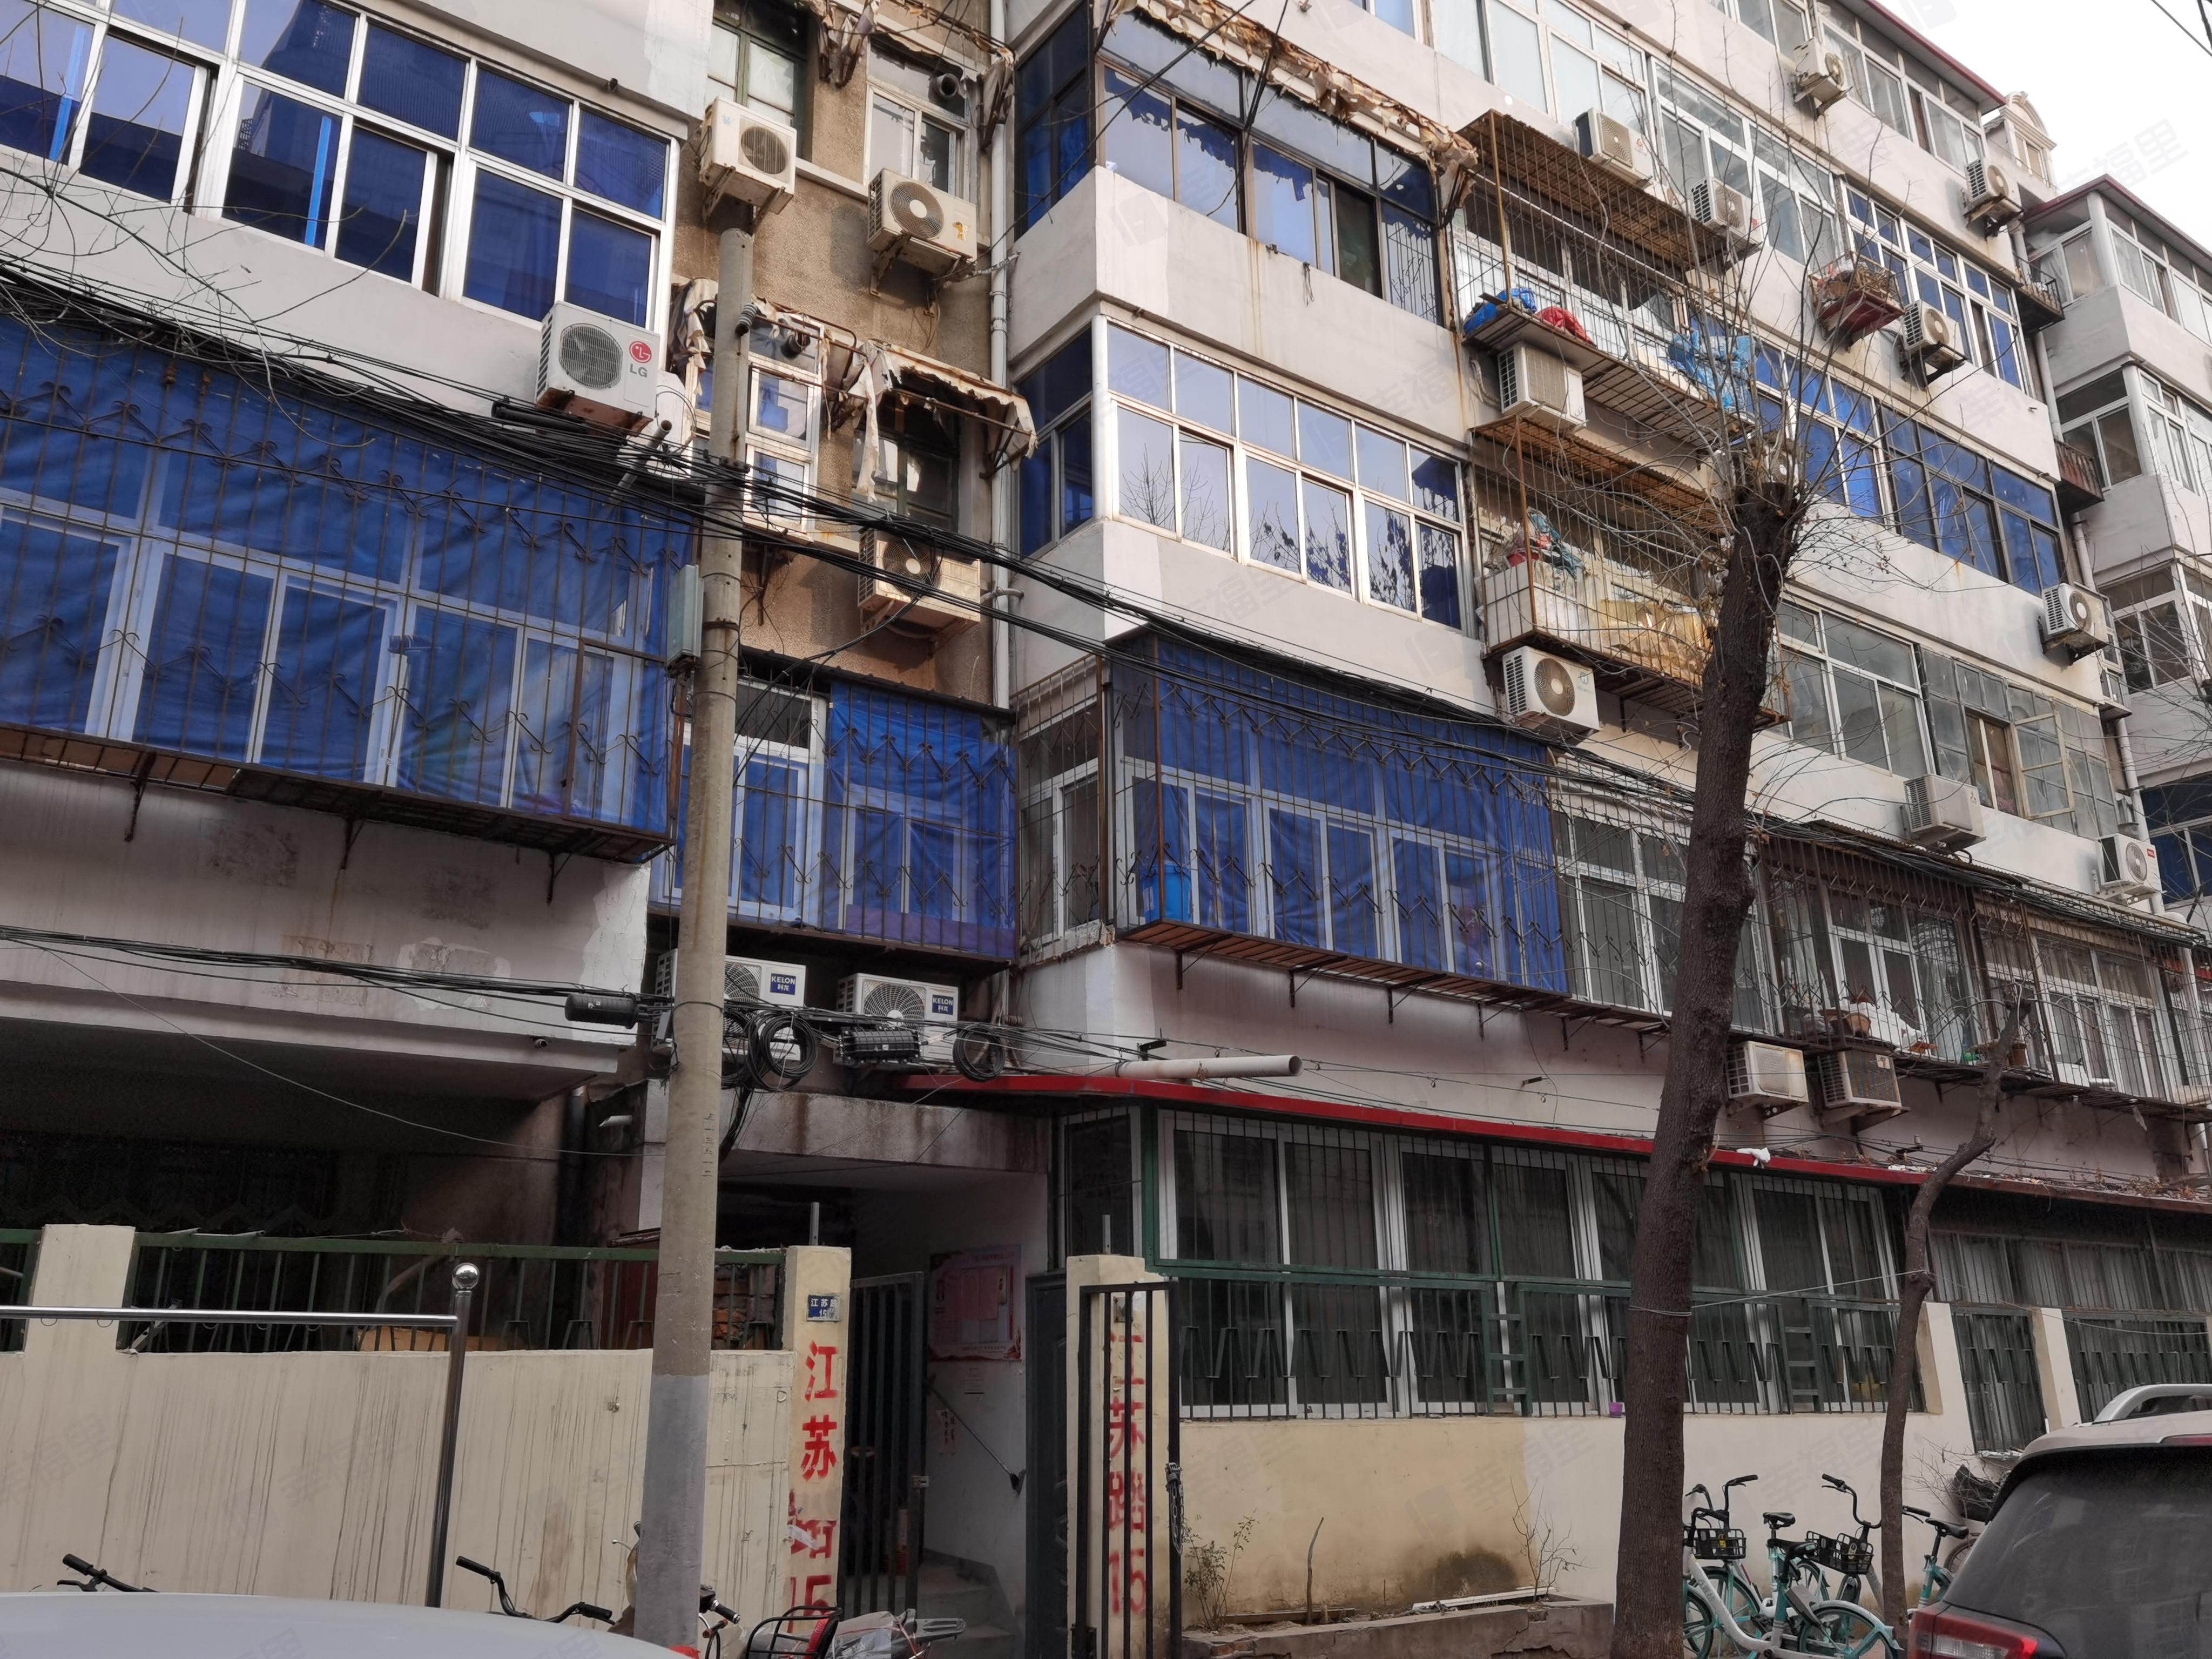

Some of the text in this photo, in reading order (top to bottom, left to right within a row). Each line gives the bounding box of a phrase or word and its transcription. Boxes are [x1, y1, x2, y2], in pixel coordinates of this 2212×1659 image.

[630, 363, 648, 377] LG
[771, 975, 795, 984] KELON
[933, 997, 953, 1006] KELON
[811, 1298, 838, 1307] 江苏路
